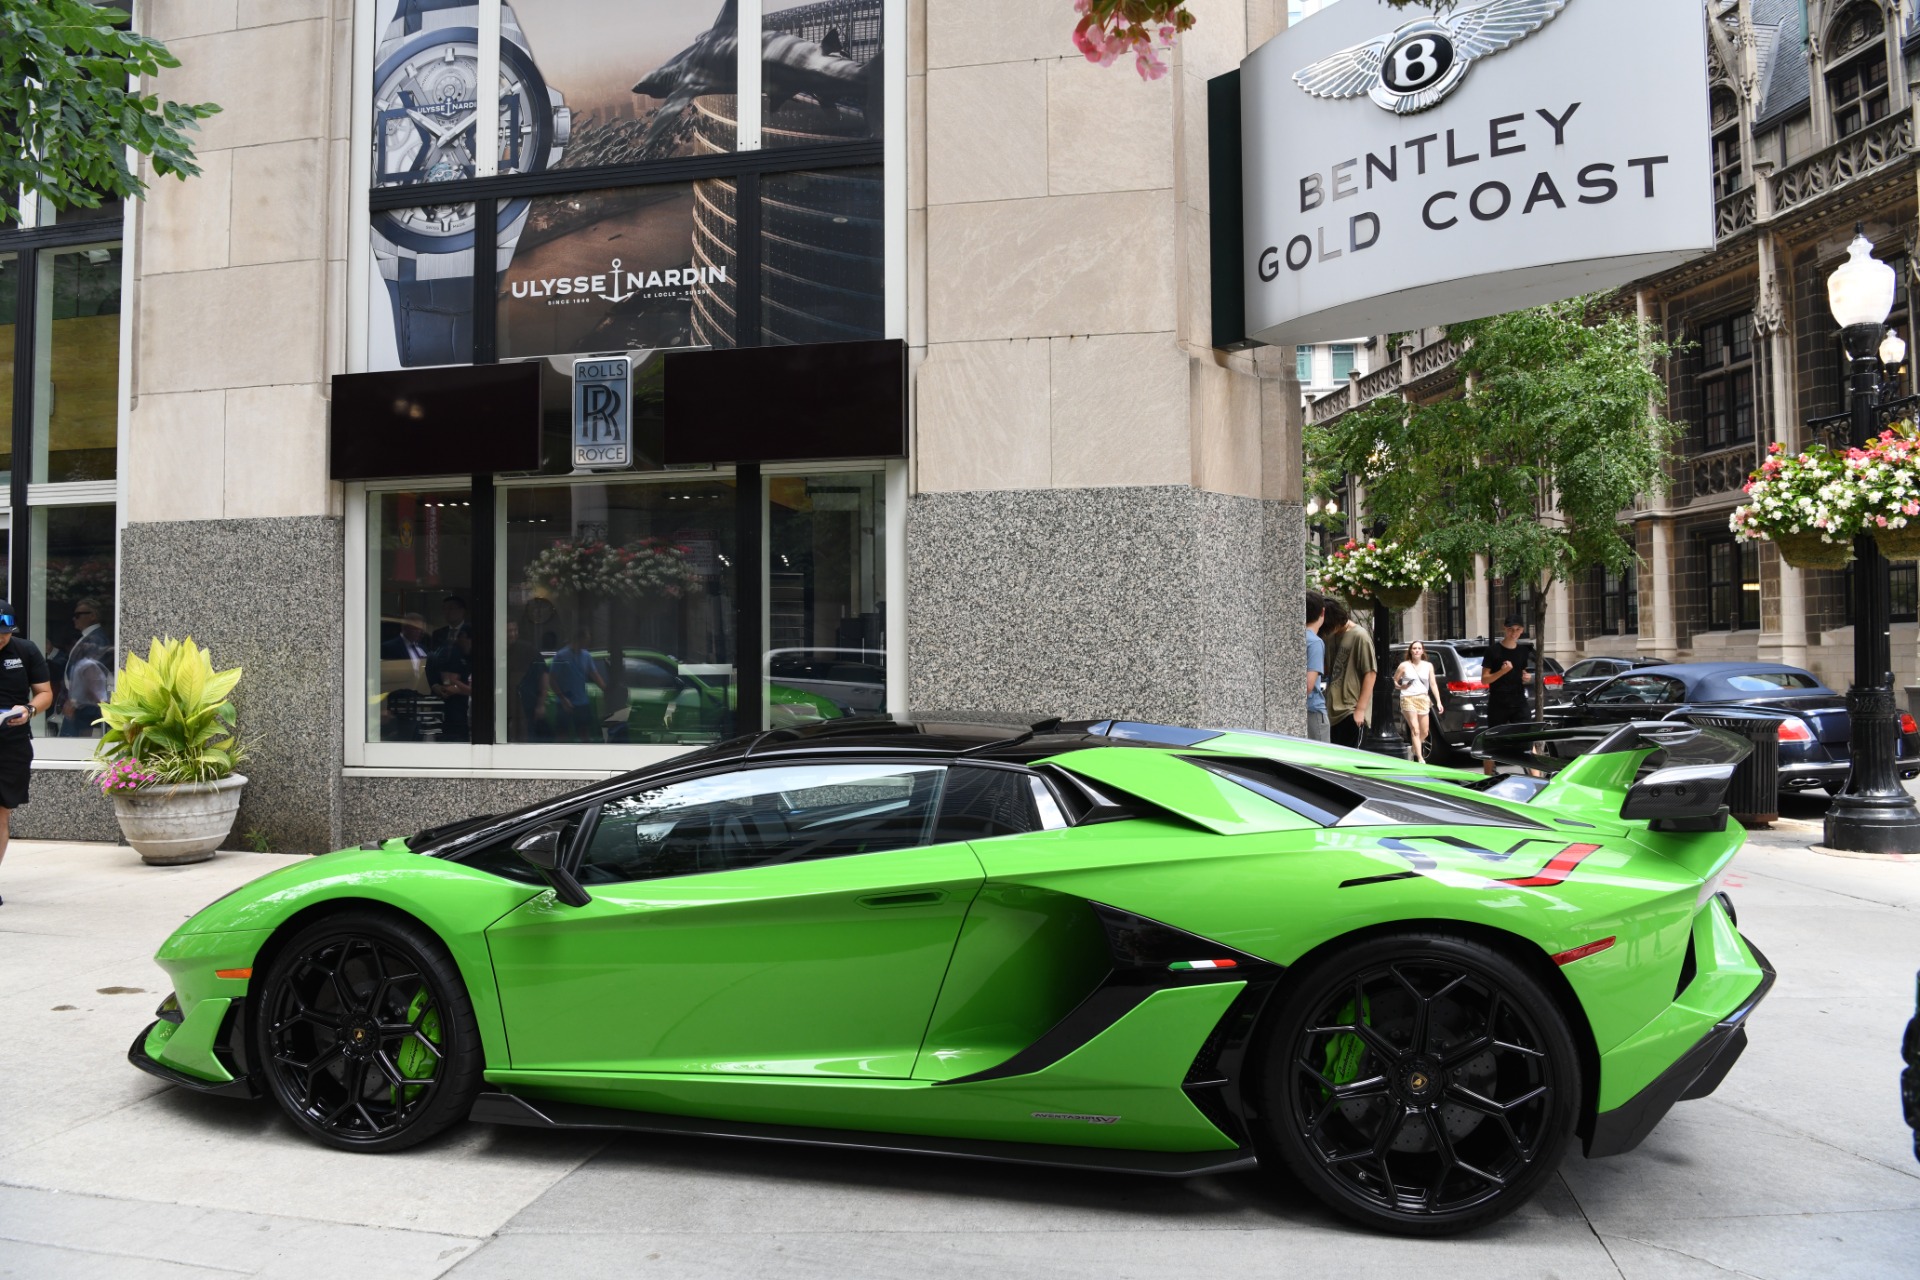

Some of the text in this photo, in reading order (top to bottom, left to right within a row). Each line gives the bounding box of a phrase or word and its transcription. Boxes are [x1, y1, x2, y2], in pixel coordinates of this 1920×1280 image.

[417, 104, 446, 115] ULYSSE
[1299, 102, 1582, 214] BENTLEY
[1258, 155, 1669, 283] GOLD COAST
[511, 265, 727, 299] ULYSSE NARDIN
[578, 363, 624, 378] ROLLS
[577, 447, 624, 461] ROYCE
